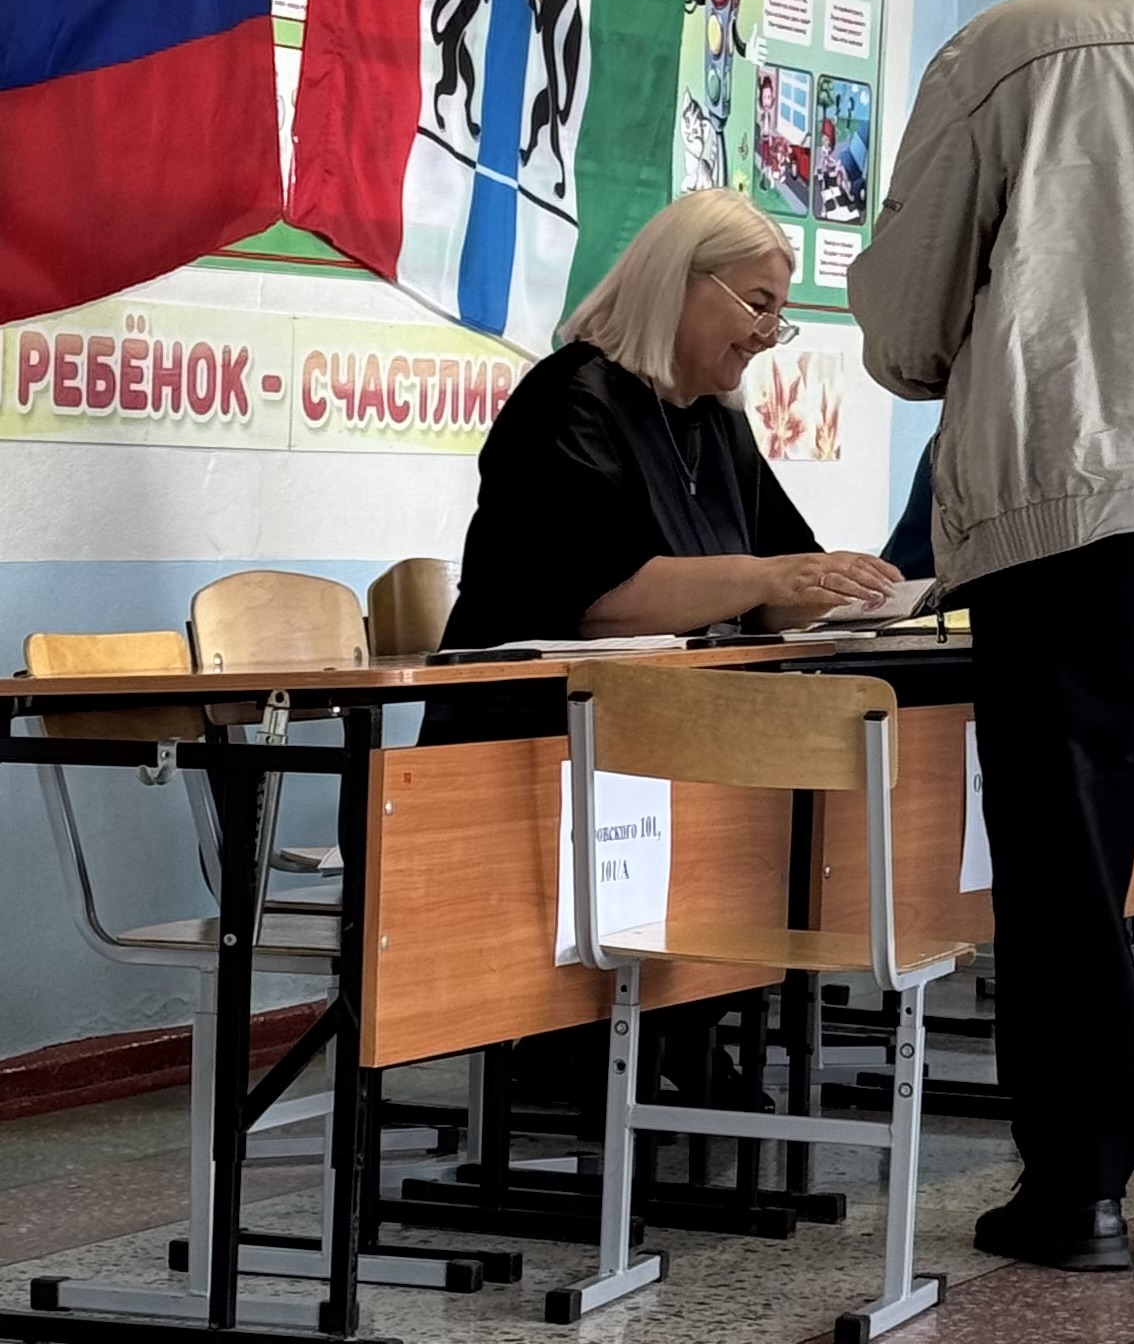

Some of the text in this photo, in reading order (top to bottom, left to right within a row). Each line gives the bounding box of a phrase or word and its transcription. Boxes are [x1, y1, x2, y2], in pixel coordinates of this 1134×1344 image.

[17, 314, 532, 425] РЕБЁНОК - СЧАСТЛИВ
[640, 815, 662, 841] 101,
